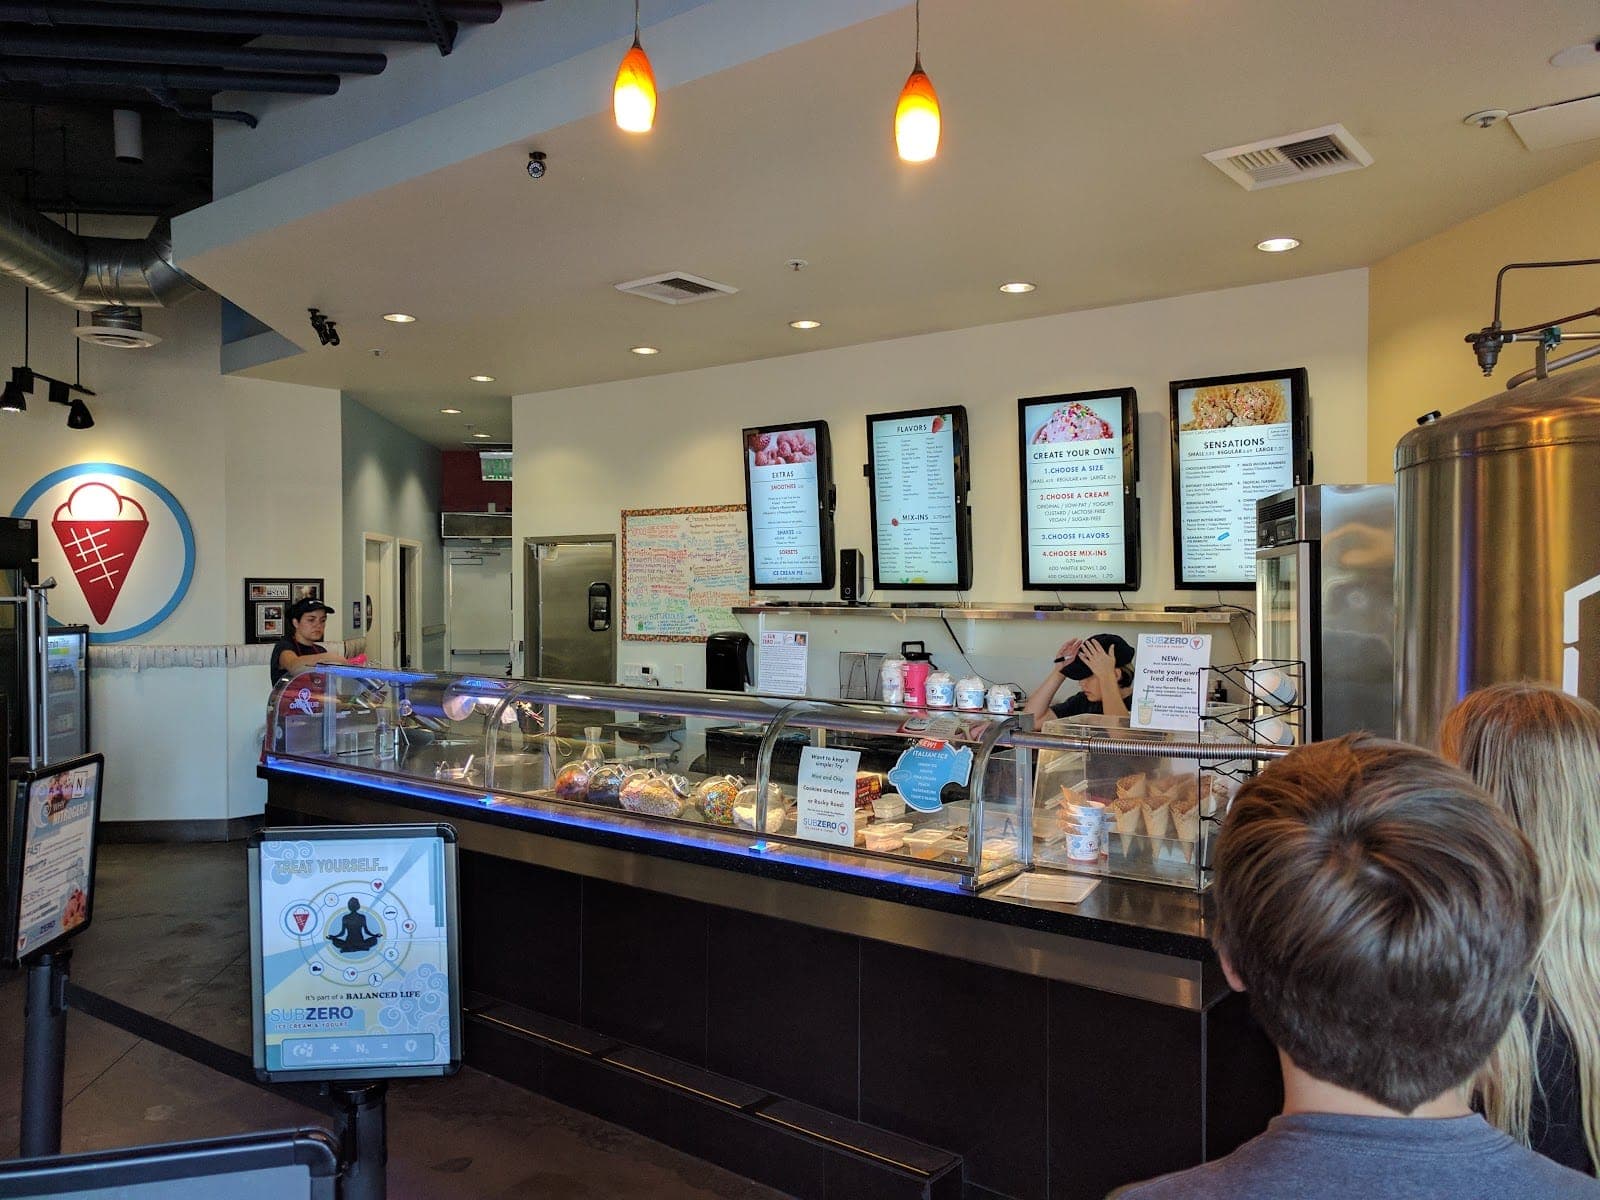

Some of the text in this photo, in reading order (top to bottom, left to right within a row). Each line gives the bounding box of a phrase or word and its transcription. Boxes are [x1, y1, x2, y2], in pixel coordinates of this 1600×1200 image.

[897, 423, 927, 433] FLAVORS
[1204, 437, 1265, 449] SENSATIONS
[1033, 447, 1115, 460] CREATE YOUR OWN
[772, 470, 794, 479] EXTRAS
[1084, 491, 1111, 499] CREAM
[902, 513, 929, 521] MIX-INS
[1078, 532, 1110, 540] FLAVORS
[1145, 636, 1189, 645] SUBZERO
[913, 750, 937, 758] ITALIAN
[832, 755, 844, 763] keep
[802, 817, 837, 830] SUBZERO
[275, 859, 314, 874] TREAT
[317, 993, 331, 1002] part
[346, 991, 397, 1001] BALANCED
[400, 990, 421, 999] LIFE
[270, 1006, 354, 1022] SUBZERO
